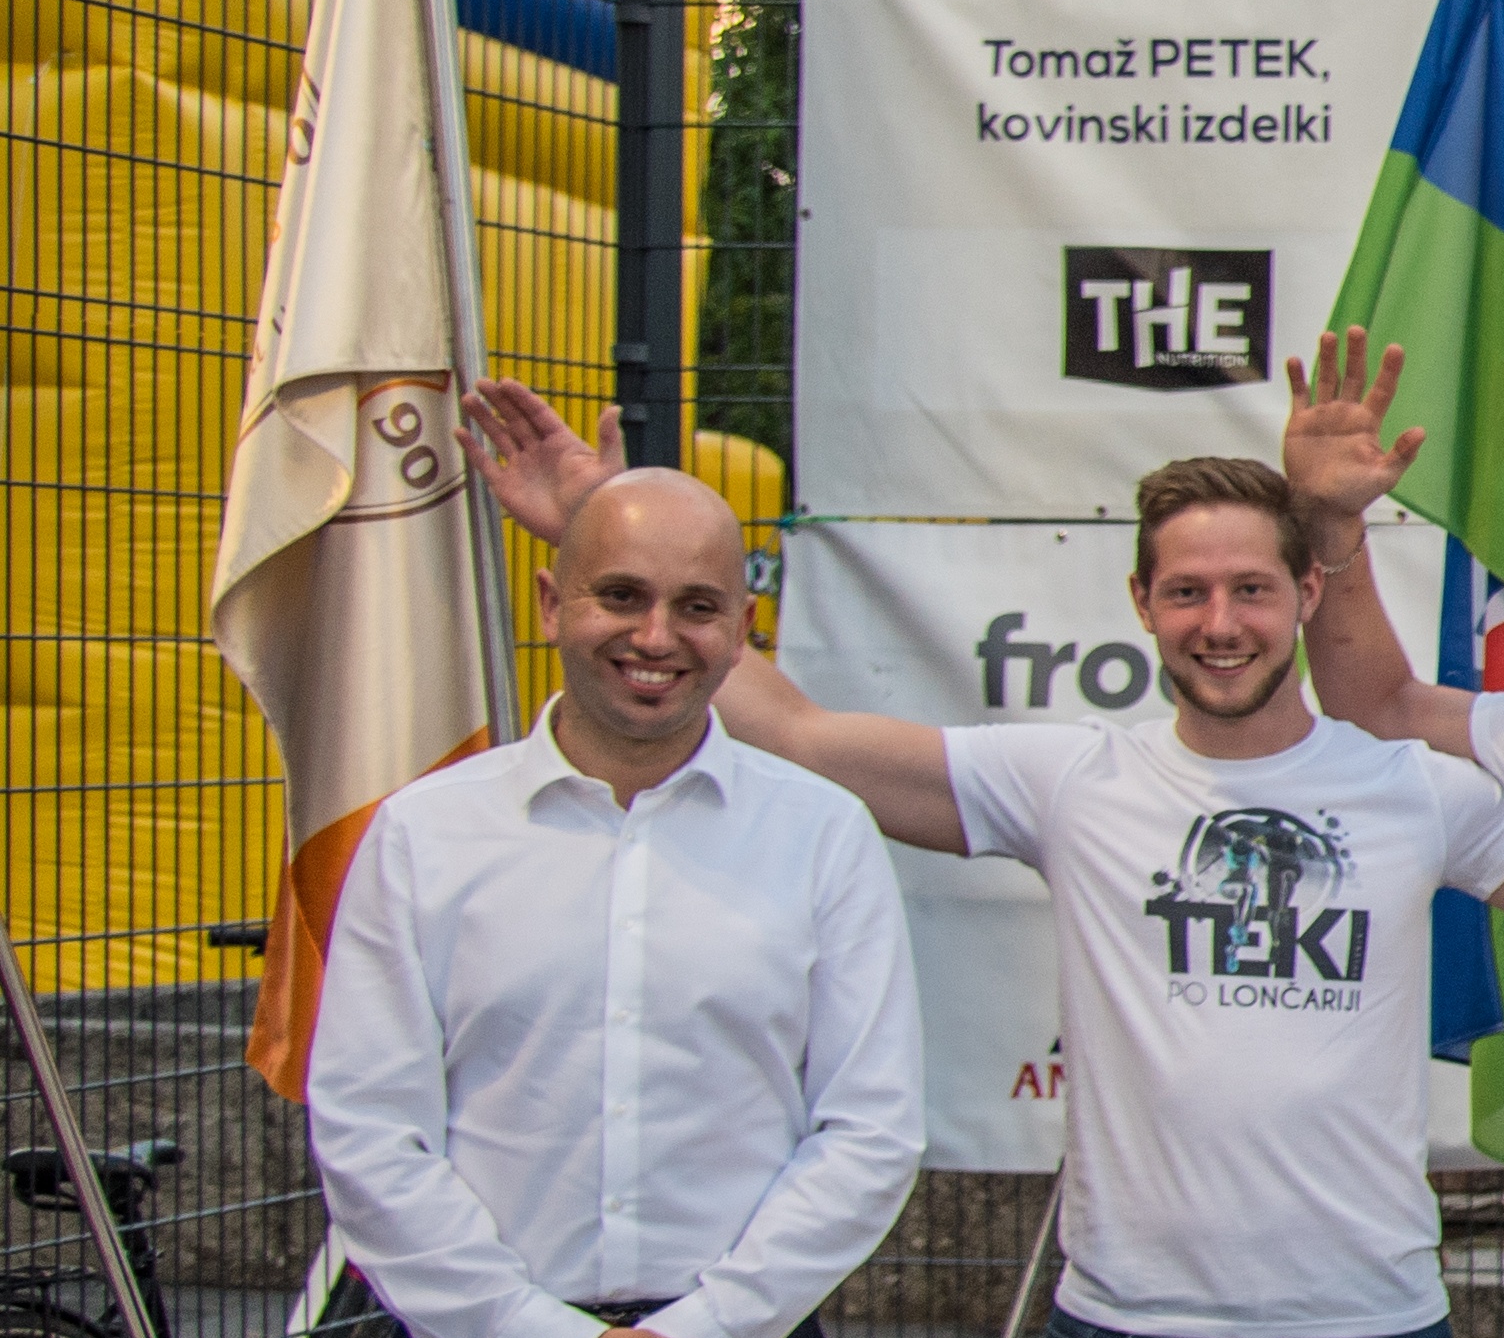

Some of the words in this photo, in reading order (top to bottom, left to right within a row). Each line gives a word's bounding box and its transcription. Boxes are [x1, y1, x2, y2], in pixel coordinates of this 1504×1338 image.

[983, 38, 1138, 80] Tomaž
[1148, 37, 1332, 83] PETEK,
[977, 102, 1169, 144] kovinski
[1181, 102, 1333, 144] izdelki
[1080, 266, 1253, 369] THE
[1144, 899, 1372, 983] TEKI
[1167, 980, 1208, 1006] PO
[1218, 981, 1363, 1012] LONČARIJI
